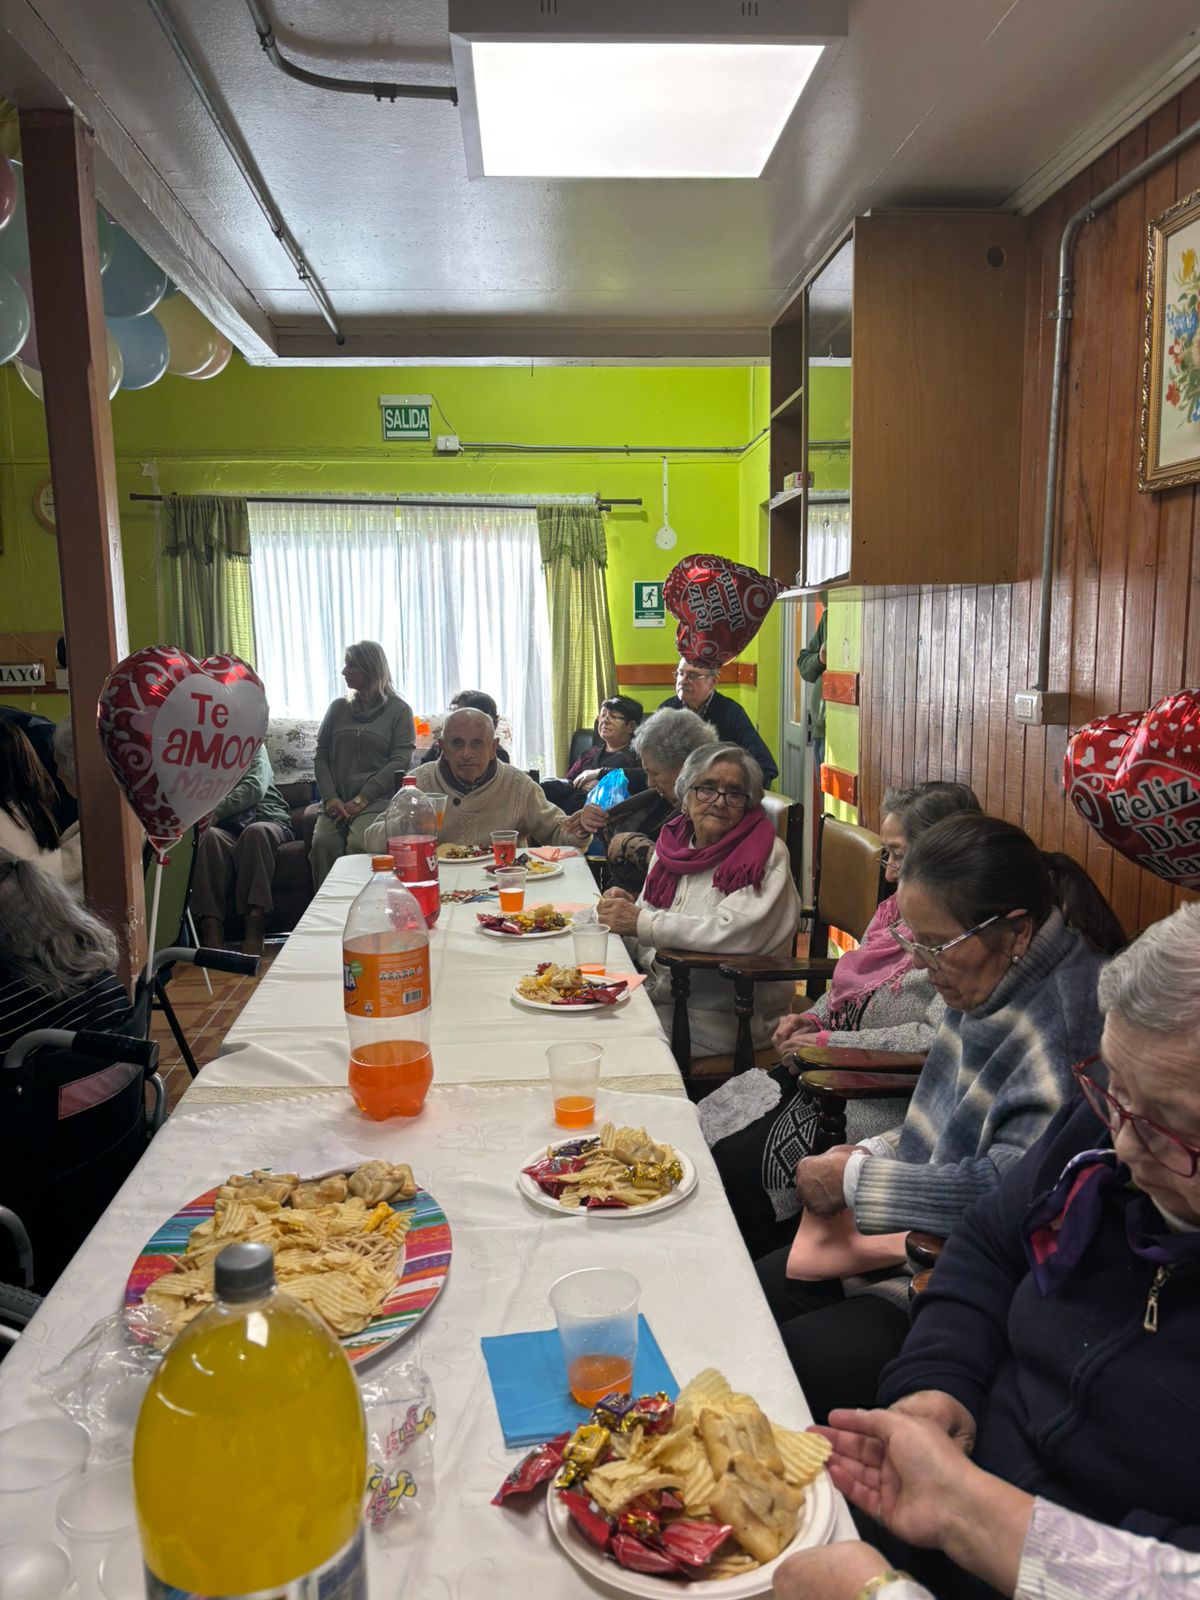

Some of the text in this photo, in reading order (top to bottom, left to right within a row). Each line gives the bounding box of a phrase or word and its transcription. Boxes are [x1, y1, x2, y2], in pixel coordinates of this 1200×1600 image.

[385, 408, 429, 429] SALIDA
[688, 584, 712, 631] Feliz
[706, 584, 727, 622] Día
[716, 571, 745, 630] Mamá
[190, 692, 229, 729] Te
[161, 728, 263, 770] aMOO
[1109, 776, 1198, 826] Feliz
[1134, 816, 1200, 851] Día
[1139, 853, 1200, 877] Ma
